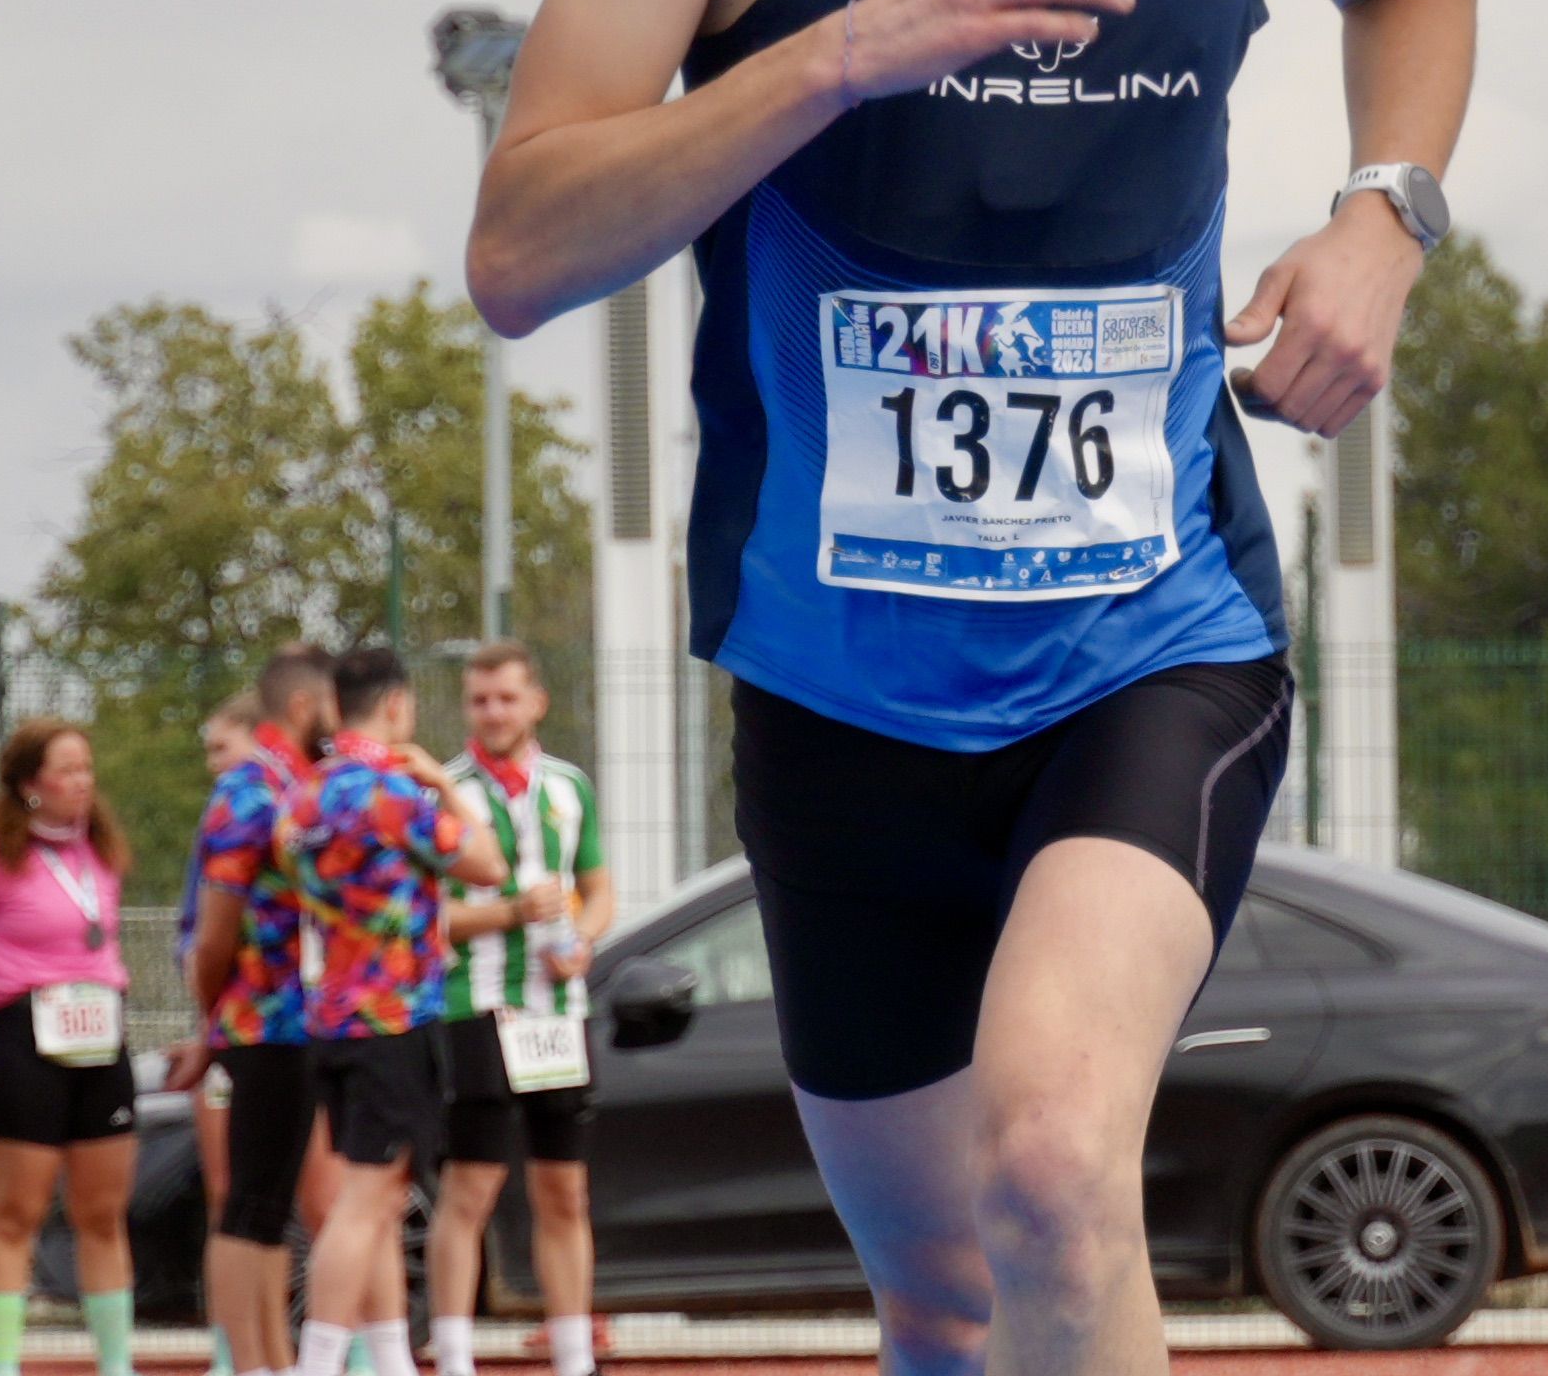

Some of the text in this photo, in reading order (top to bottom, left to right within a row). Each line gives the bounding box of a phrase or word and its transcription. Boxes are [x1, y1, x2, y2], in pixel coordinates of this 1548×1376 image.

[1052, 320, 1093, 335] LUCENA
[1103, 315, 1156, 330] carreras
[876, 306, 984, 375] 21K
[1102, 324, 1165, 344] populares
[1052, 350, 1094, 373] 2026
[880, 386, 1116, 503] 1376
[941, 515, 1072, 526] JAVIER SANCHEZ PRIETO
[978, 534, 1006, 543] TALLA
